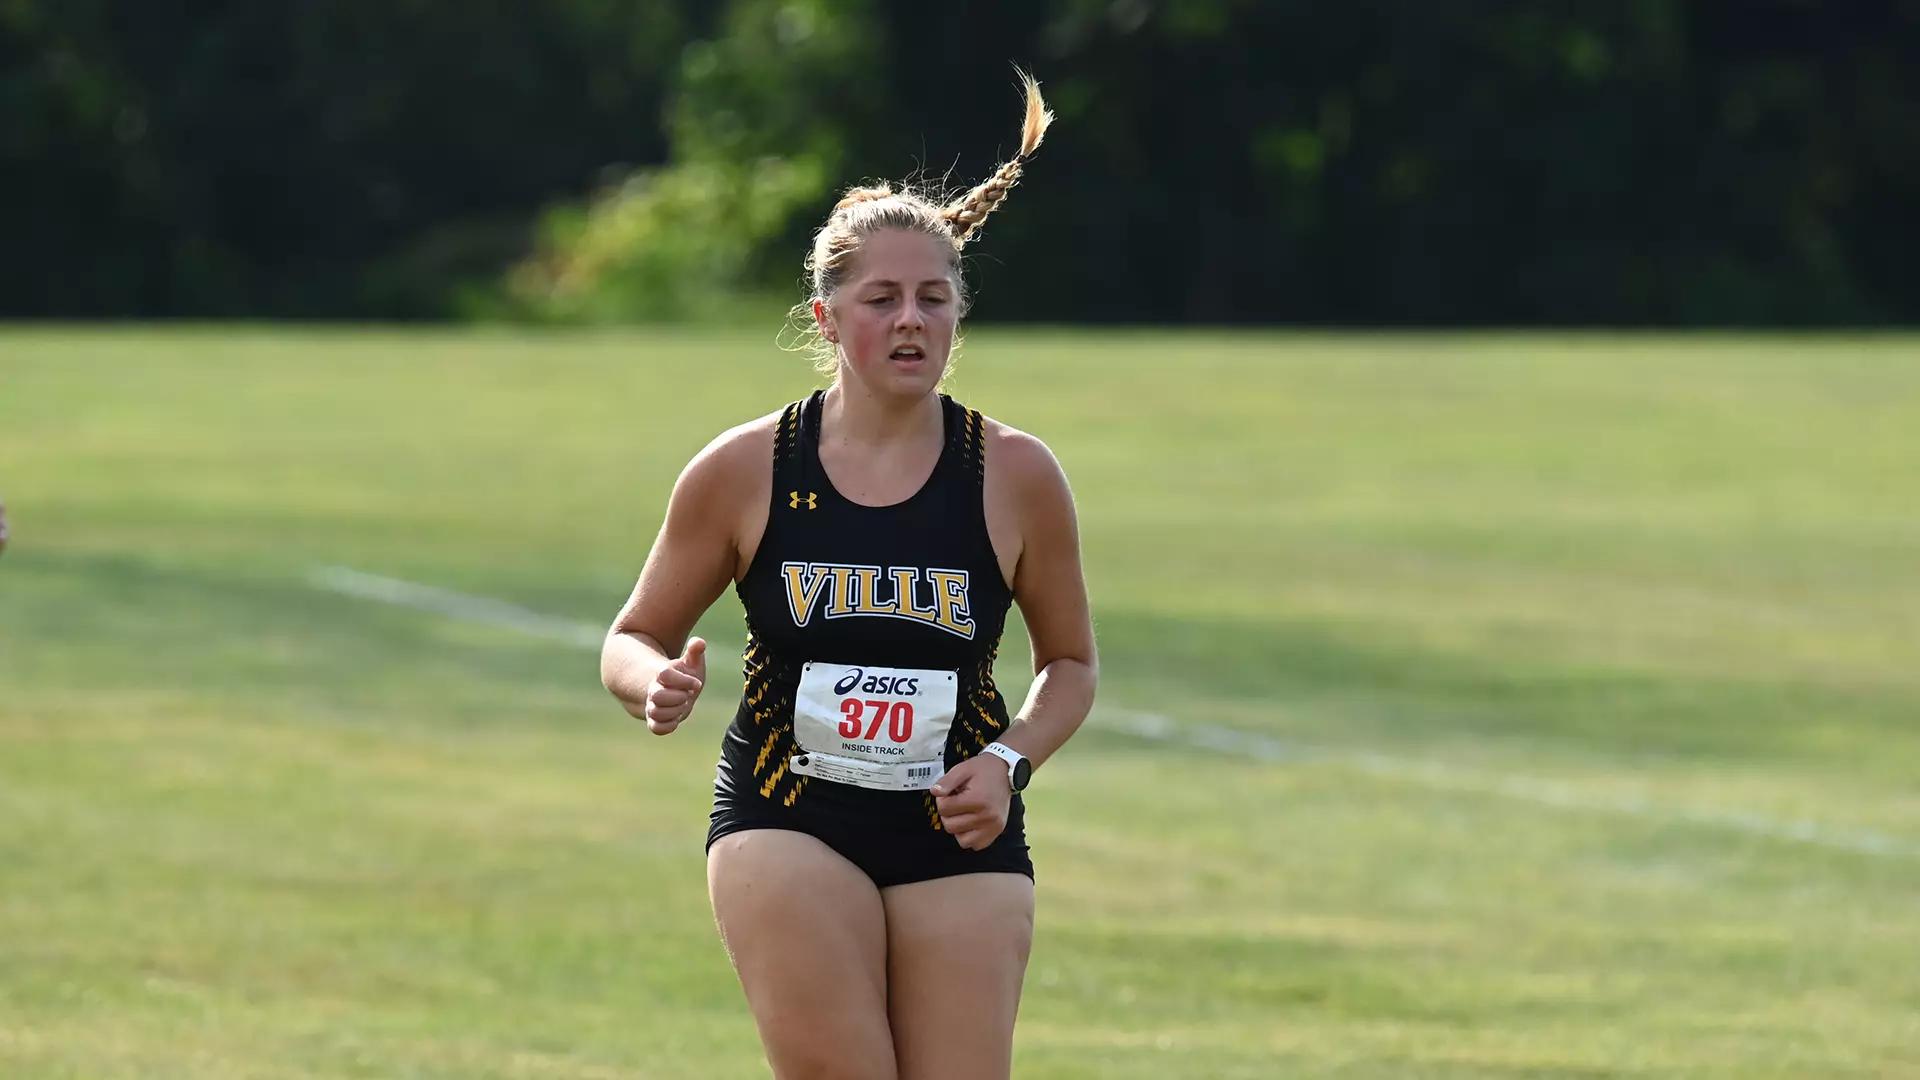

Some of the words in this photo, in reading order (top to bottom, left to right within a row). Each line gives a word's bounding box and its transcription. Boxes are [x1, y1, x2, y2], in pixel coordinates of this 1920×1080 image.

[781, 561, 976, 641] VILLE
[838, 698, 914, 743] 370
[841, 742, 872, 754] INSIDE
[874, 746, 905, 755] TRACK
